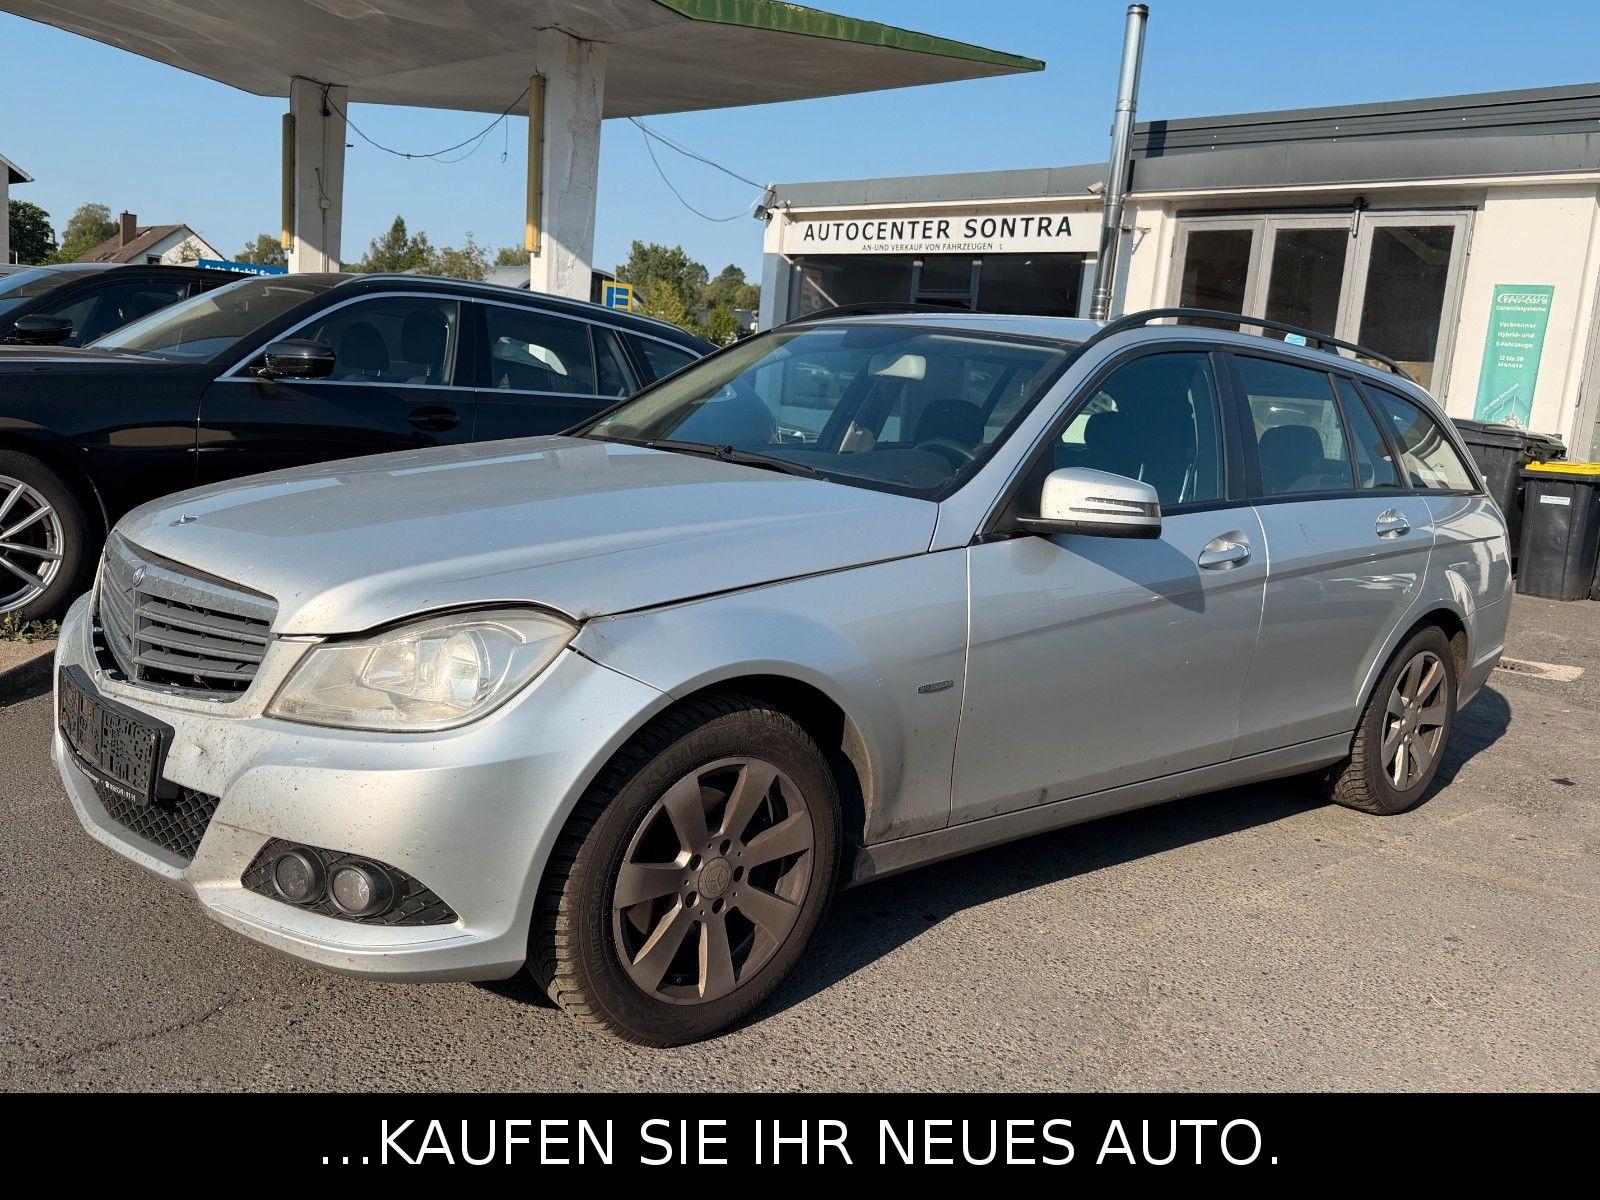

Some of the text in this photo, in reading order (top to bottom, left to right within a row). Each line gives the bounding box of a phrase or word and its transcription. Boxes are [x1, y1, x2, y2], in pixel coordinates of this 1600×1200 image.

[804, 215, 1072, 241] AUTOCENTER SONTRA
[891, 243, 922, 251] VERKAUF
[925, 243, 940, 251] VON
[942, 242, 993, 251] FAHRZEUGEN
[1499, 321, 1537, 329] Verbrenner
[1498, 361, 1524, 369] Monate
